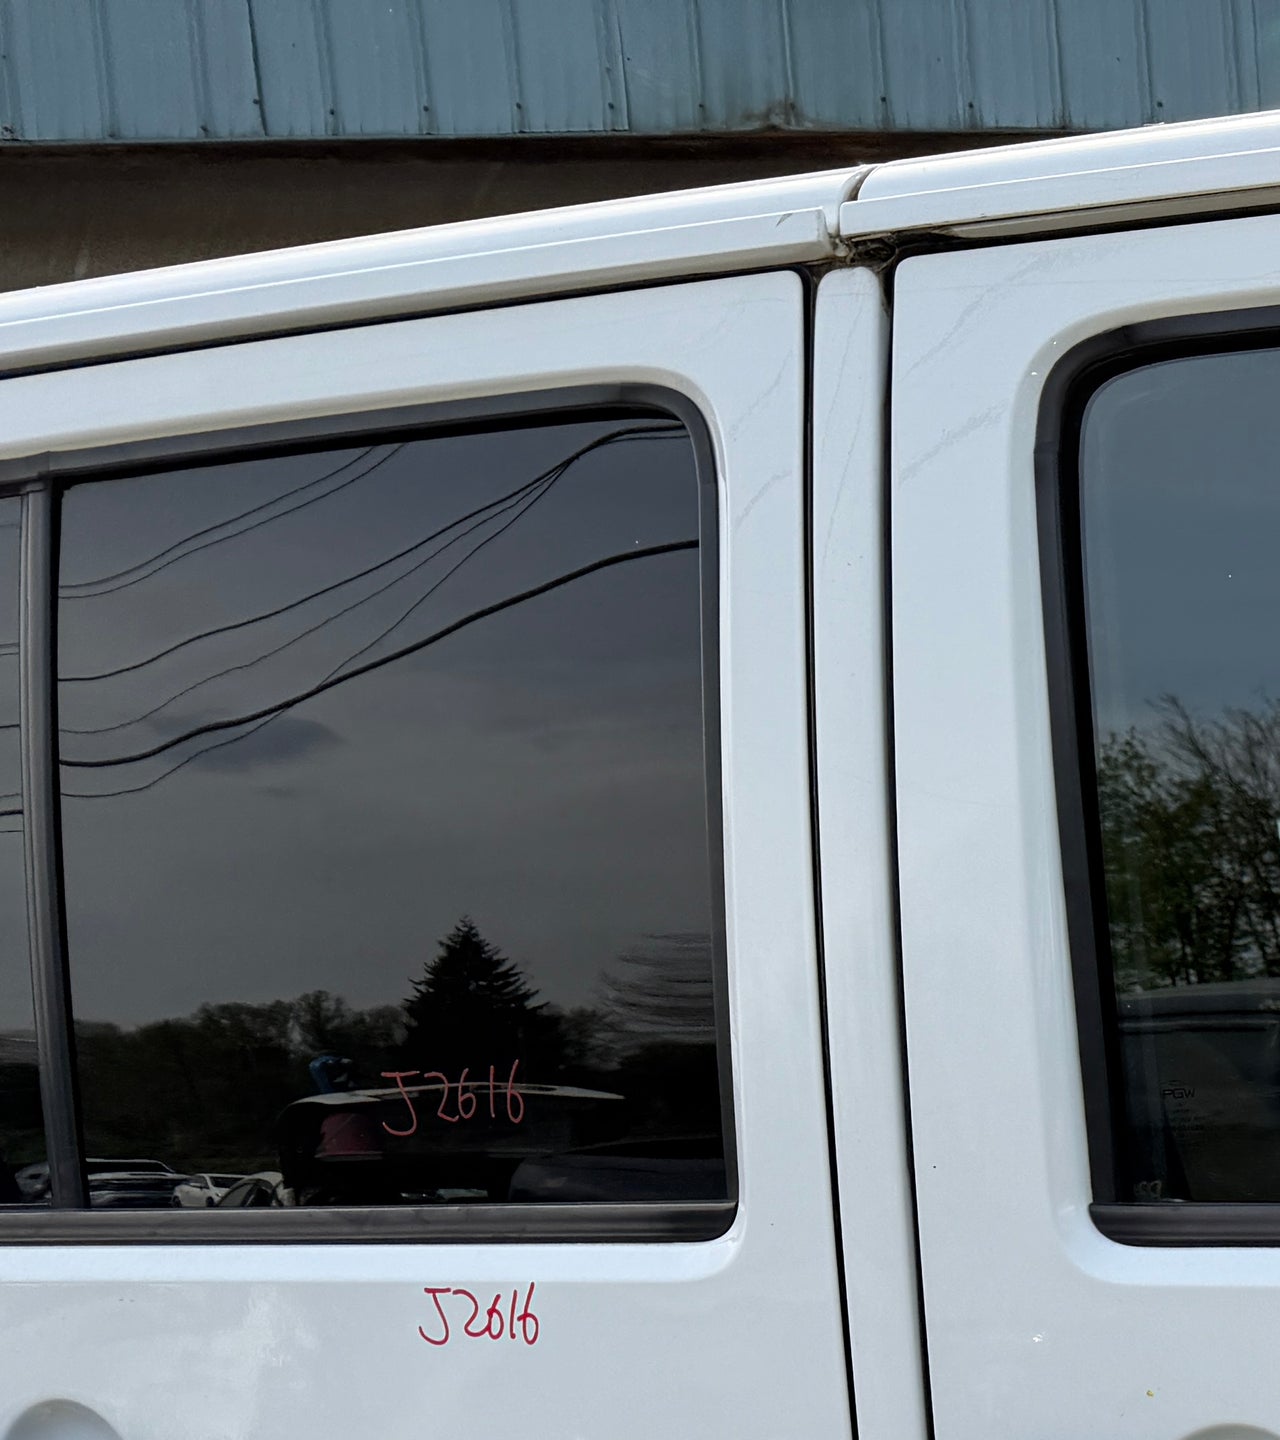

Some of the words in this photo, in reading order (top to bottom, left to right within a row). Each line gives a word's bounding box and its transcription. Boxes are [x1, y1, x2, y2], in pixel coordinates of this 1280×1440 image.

[381, 1059, 524, 1136] J2616
[1162, 1087, 1196, 1099] PGW
[419, 1282, 539, 1345] J2616
